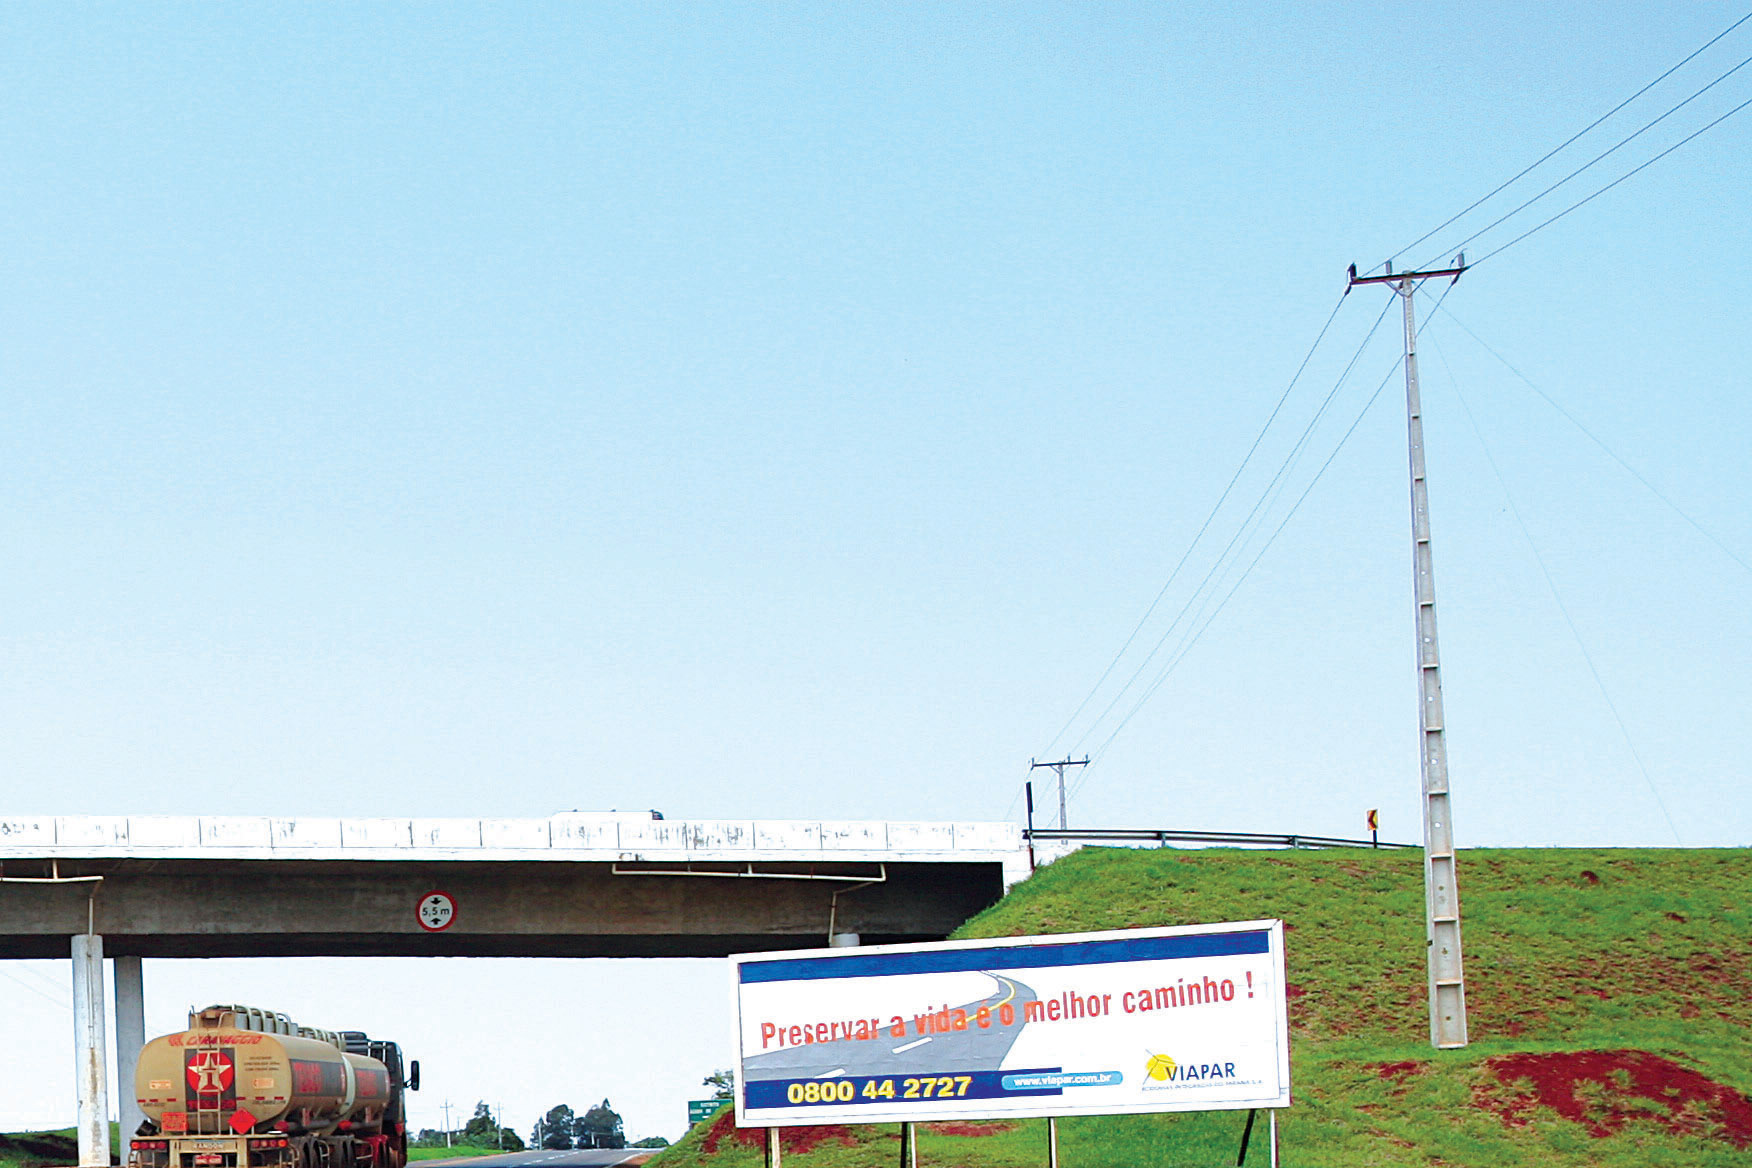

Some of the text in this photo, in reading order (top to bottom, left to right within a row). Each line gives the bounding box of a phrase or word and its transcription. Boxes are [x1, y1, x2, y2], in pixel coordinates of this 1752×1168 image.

[422, 906, 438, 917] 5,5
[761, 1016, 880, 1049] Preservar
[889, 1015, 906, 1038] a
[914, 1004, 968, 1035] vida
[976, 1000, 992, 1029] é
[999, 1001, 1015, 1026] o
[1023, 991, 1111, 1024] melhor
[1123, 976, 1235, 1014] caminho
[1013, 1073, 1112, 1086] www.viapar.com.br
[1166, 1062, 1236, 1081] VIAPAR
[787, 1076, 973, 1104] 0800 44 2727
